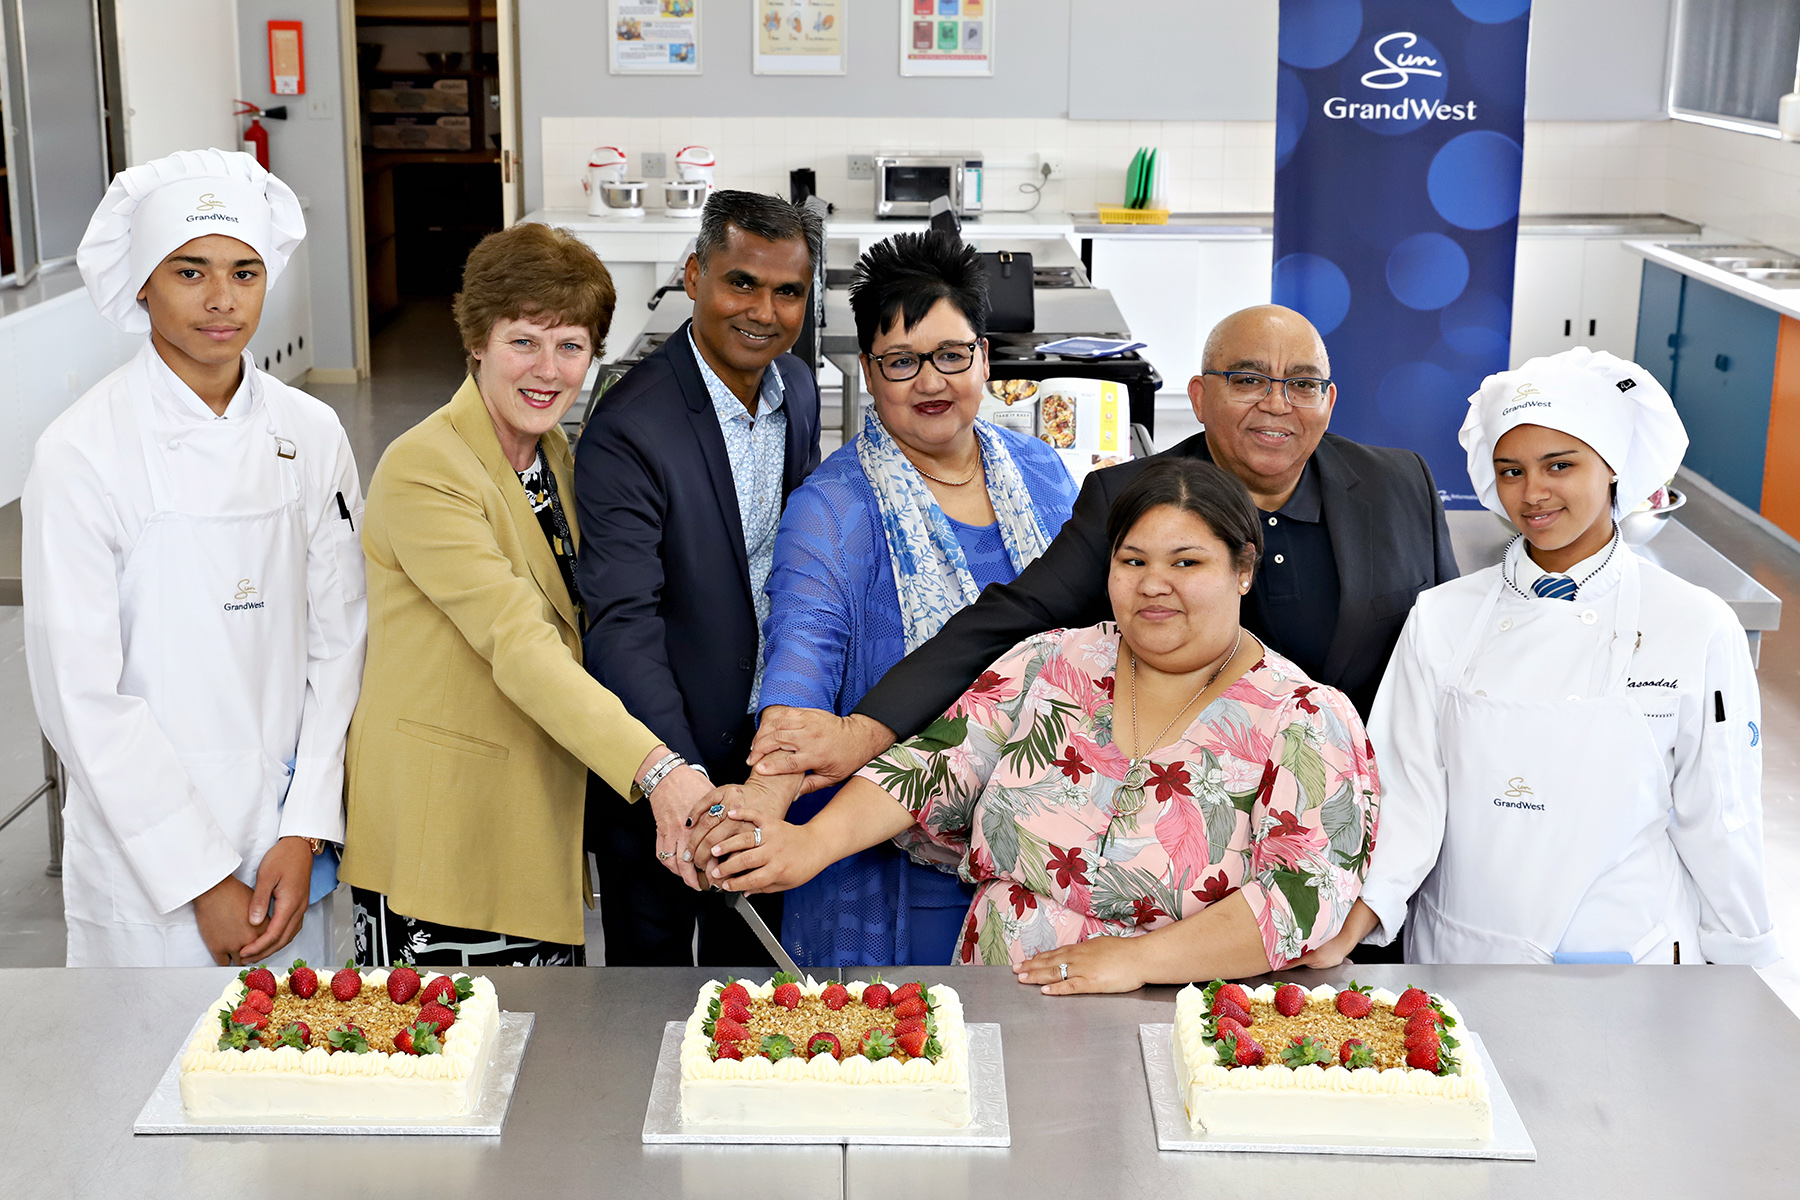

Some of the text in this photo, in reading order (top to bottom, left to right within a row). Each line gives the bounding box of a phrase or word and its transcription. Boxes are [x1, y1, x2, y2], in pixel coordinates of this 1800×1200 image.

[1361, 31, 1442, 89] Sun
[1323, 97, 1477, 121] GrandWest
[196, 193, 226, 211] Sun
[186, 213, 239, 223] GrandWest
[1511, 383, 1540, 402] Sun
[1502, 401, 1551, 416] GrandWest
[234, 578, 258, 599] Sun
[223, 601, 264, 611] GrandWest
[1504, 776, 1534, 797] Sun
[1493, 798, 1545, 811] GrandWest
